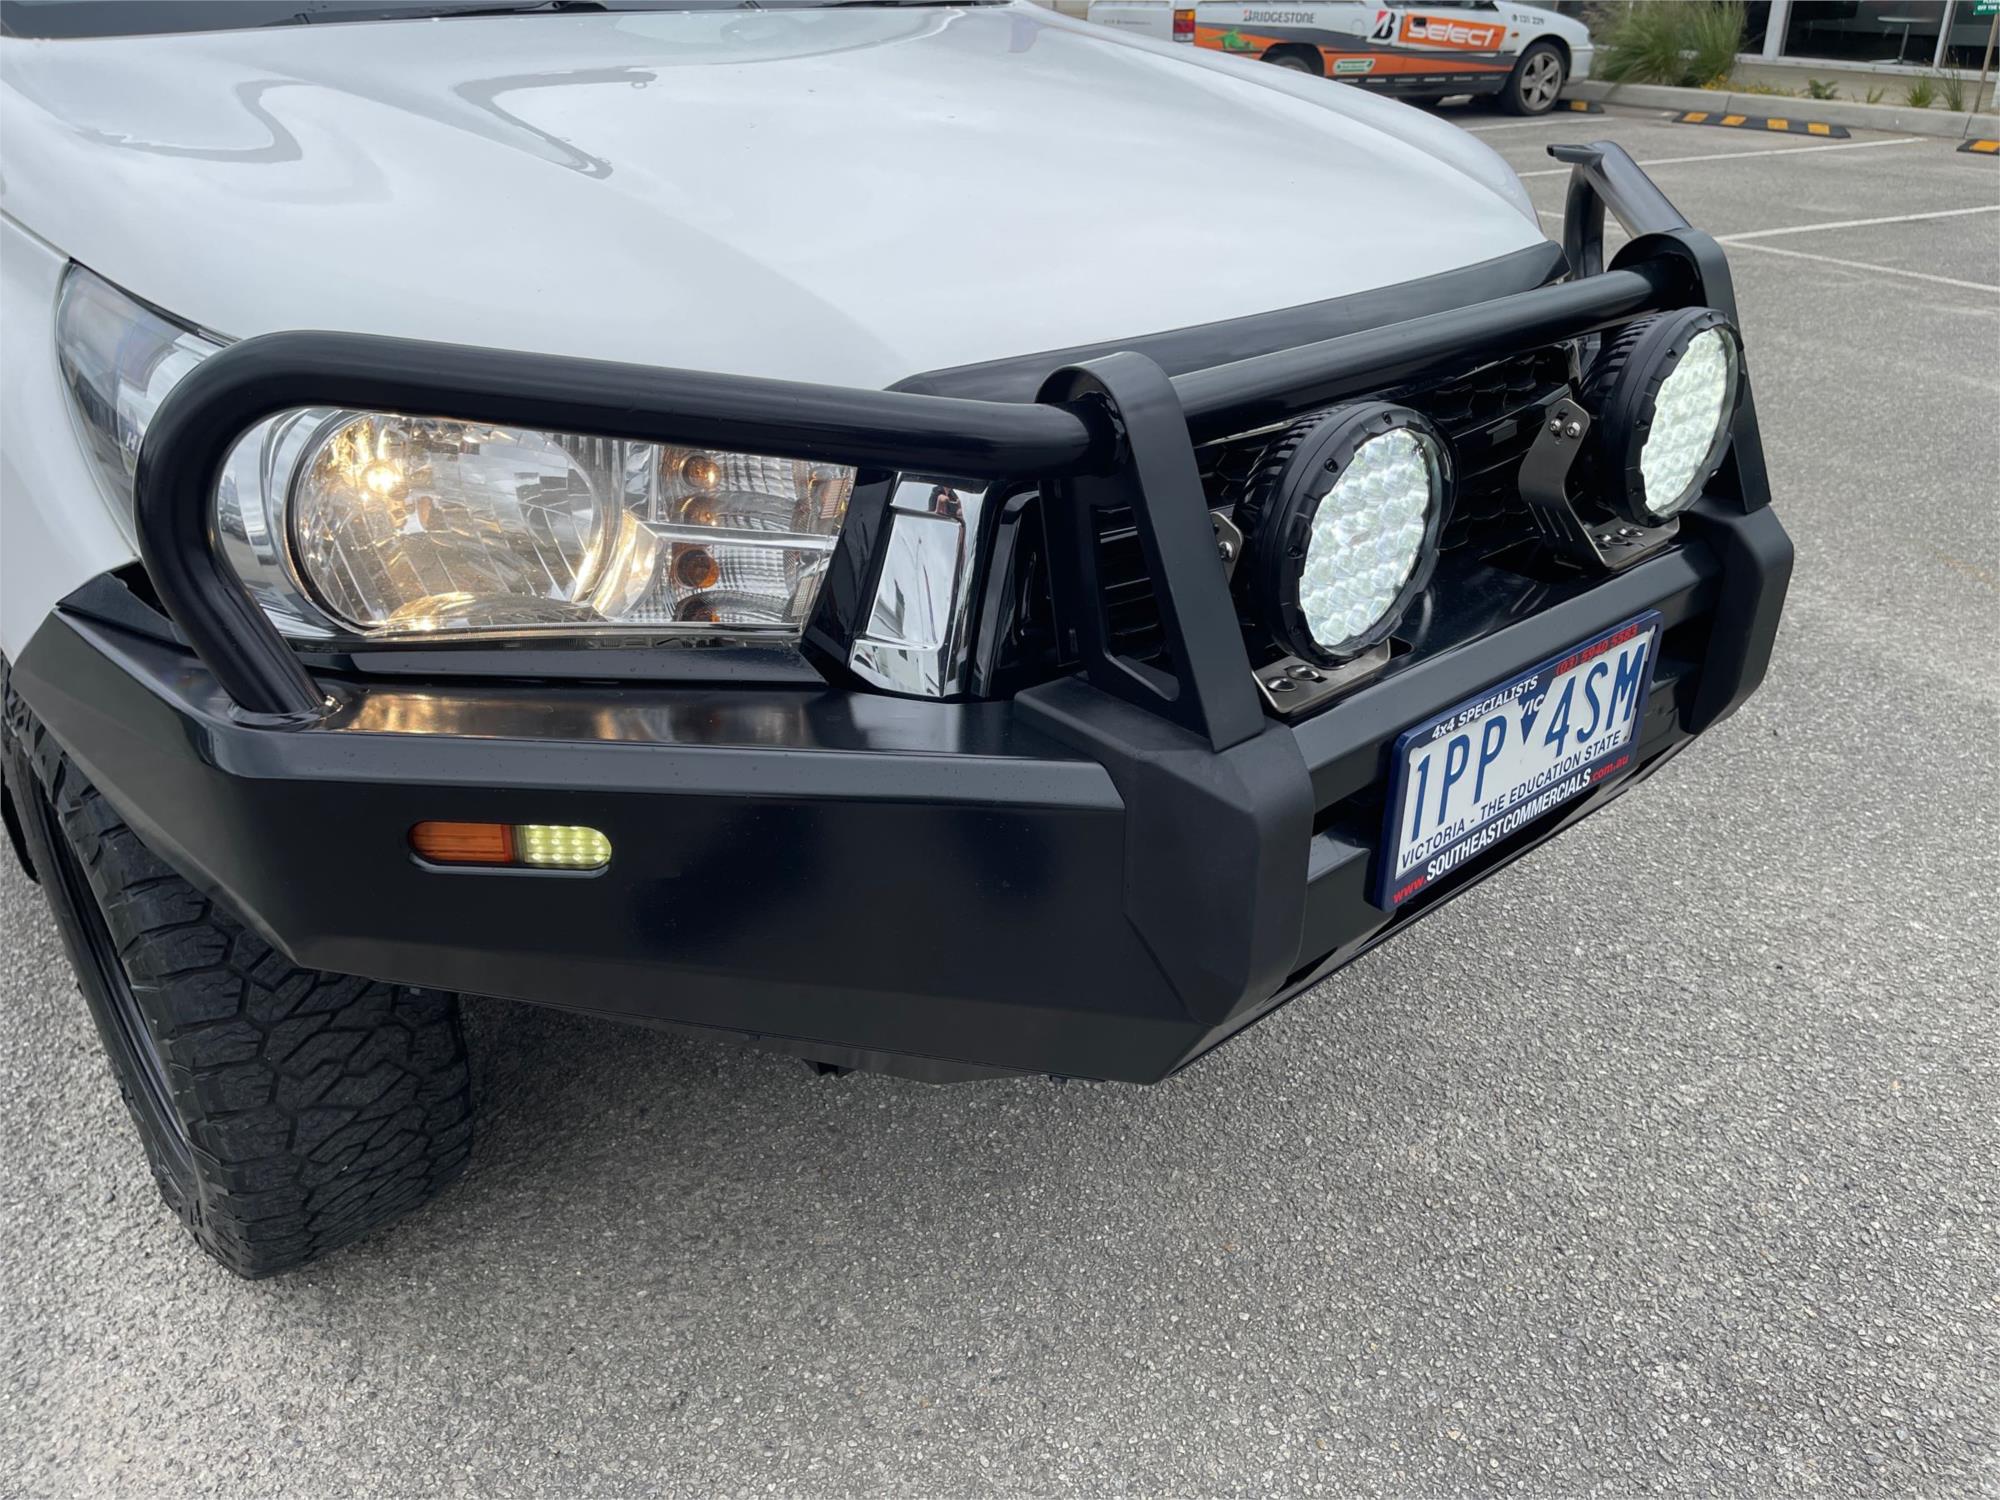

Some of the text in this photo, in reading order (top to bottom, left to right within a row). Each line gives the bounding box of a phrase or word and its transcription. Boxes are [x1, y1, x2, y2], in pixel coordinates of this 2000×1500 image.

[1243, 9, 1315, 24] BRIDGESTONE
[1432, 675, 1538, 739] 4x4 SPECIALISTS
[1521, 692, 1547, 718] VIC
[1402, 819, 1465, 868] VICTORIA
[1481, 800, 1505, 821] THE
[1509, 756, 1581, 804] EDUCATION
[1584, 730, 1621, 761] STATE
